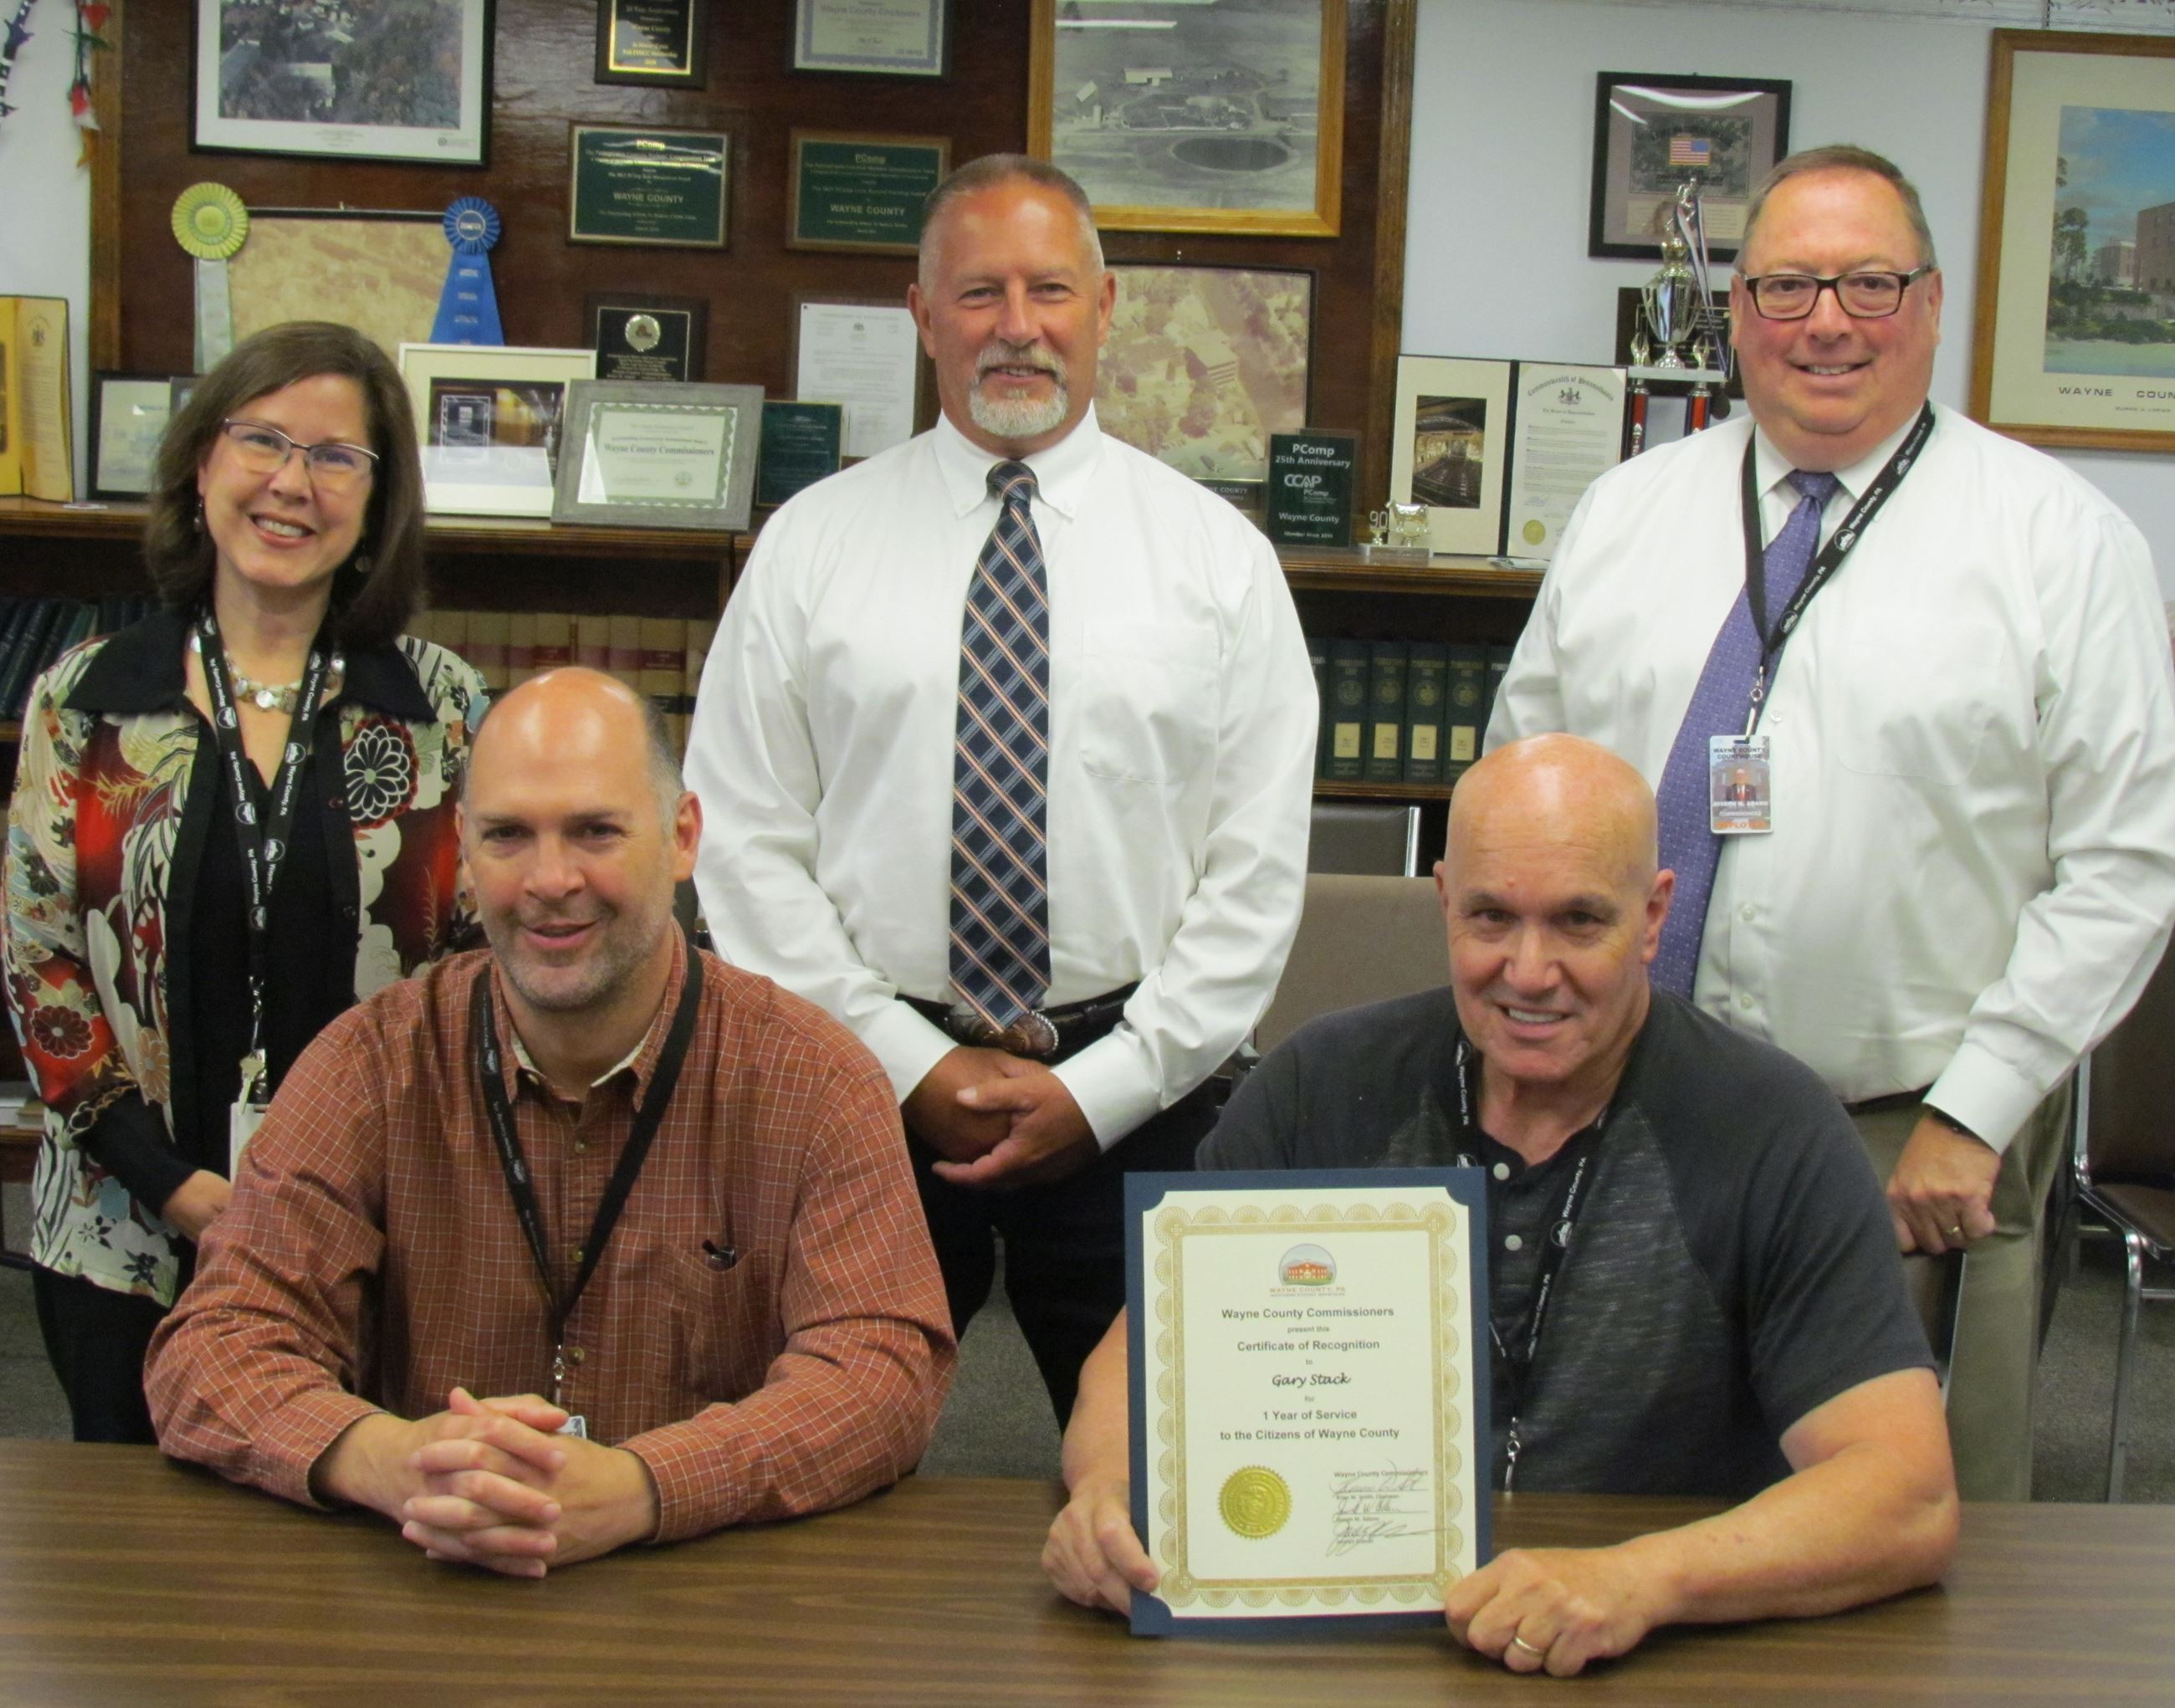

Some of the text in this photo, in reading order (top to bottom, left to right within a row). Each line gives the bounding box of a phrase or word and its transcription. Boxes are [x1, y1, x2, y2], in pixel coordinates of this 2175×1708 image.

[613, 192, 683, 203] WAYNE COUNTY
[830, 203, 905, 216] WAYNE COUNTY
[2058, 386, 2113, 396] WAYNE
[604, 443, 714, 456] Wayne County Commissioners
[1292, 443, 1335, 458] PComp
[1275, 455, 1351, 469] 25th Anniversary
[1284, 474, 1323, 488] CCAP
[1278, 512, 1340, 524] Wayne County
[1369, 510, 1389, 529] 90
[1849, 513, 1864, 529] Wayne
[1793, 593, 1806, 611] Wayne
[1817, 565, 1826, 575] PA
[310, 672, 320, 693] Wayne
[218, 688, 226, 708] Wayne
[287, 765, 297, 785] Wayne
[237, 781, 246, 801] Wayne
[279, 806, 288, 816] PA
[1462, 1115, 1469, 1126] PA
[1562, 1194, 1574, 1218] Wayne
[1579, 1157, 1587, 1168] PA
[1221, 1307, 1395, 1322] Wayne County Commissioners
[1287, 1325, 1330, 1335] present this
[1237, 1340, 1380, 1353] Certificate of Recognition
[1272, 1373, 1352, 1388] Gary Stack
[1263, 1409, 1358, 1421] 1 Year of Service
[1220, 1428, 1400, 1441] to the Citizens of Wayne County
